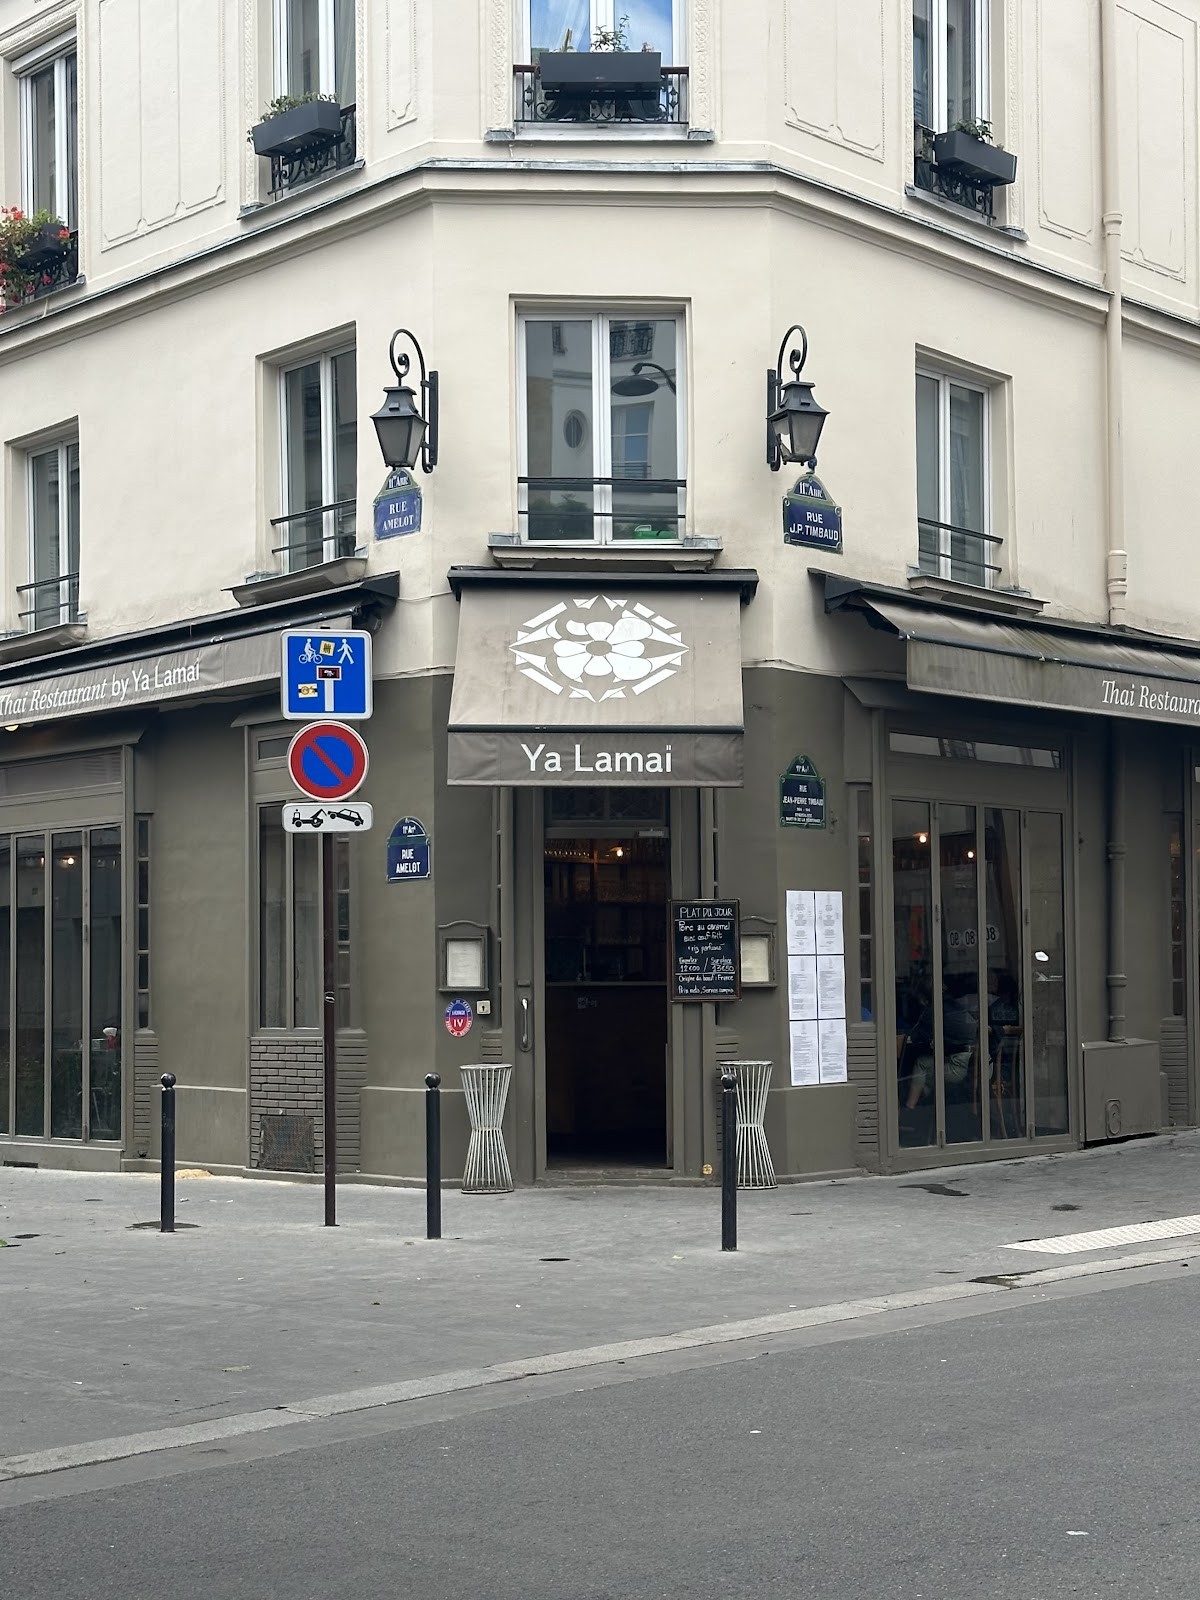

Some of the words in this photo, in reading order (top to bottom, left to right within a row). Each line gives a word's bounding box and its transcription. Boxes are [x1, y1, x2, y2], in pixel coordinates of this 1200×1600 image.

[389, 501, 408, 515] RUE
[382, 514, 414, 531] AMELOT
[806, 511, 824, 524] RUE
[29, 678, 108, 712] Restaurant
[111, 673, 130, 702] by
[131, 668, 150, 692] Ya
[1101, 680, 1135, 707] Thai
[520, 743, 562, 772] Ya
[574, 743, 672, 773] Lamaï
[401, 848, 414, 860] RUE
[395, 861, 421, 874] AMELOT
[679, 906, 701, 919] PLAT
[702, 907, 713, 918] DU
[714, 907, 734, 917] JOUR
[697, 924, 706, 932] au
[453, 1018, 464, 1028] IV
